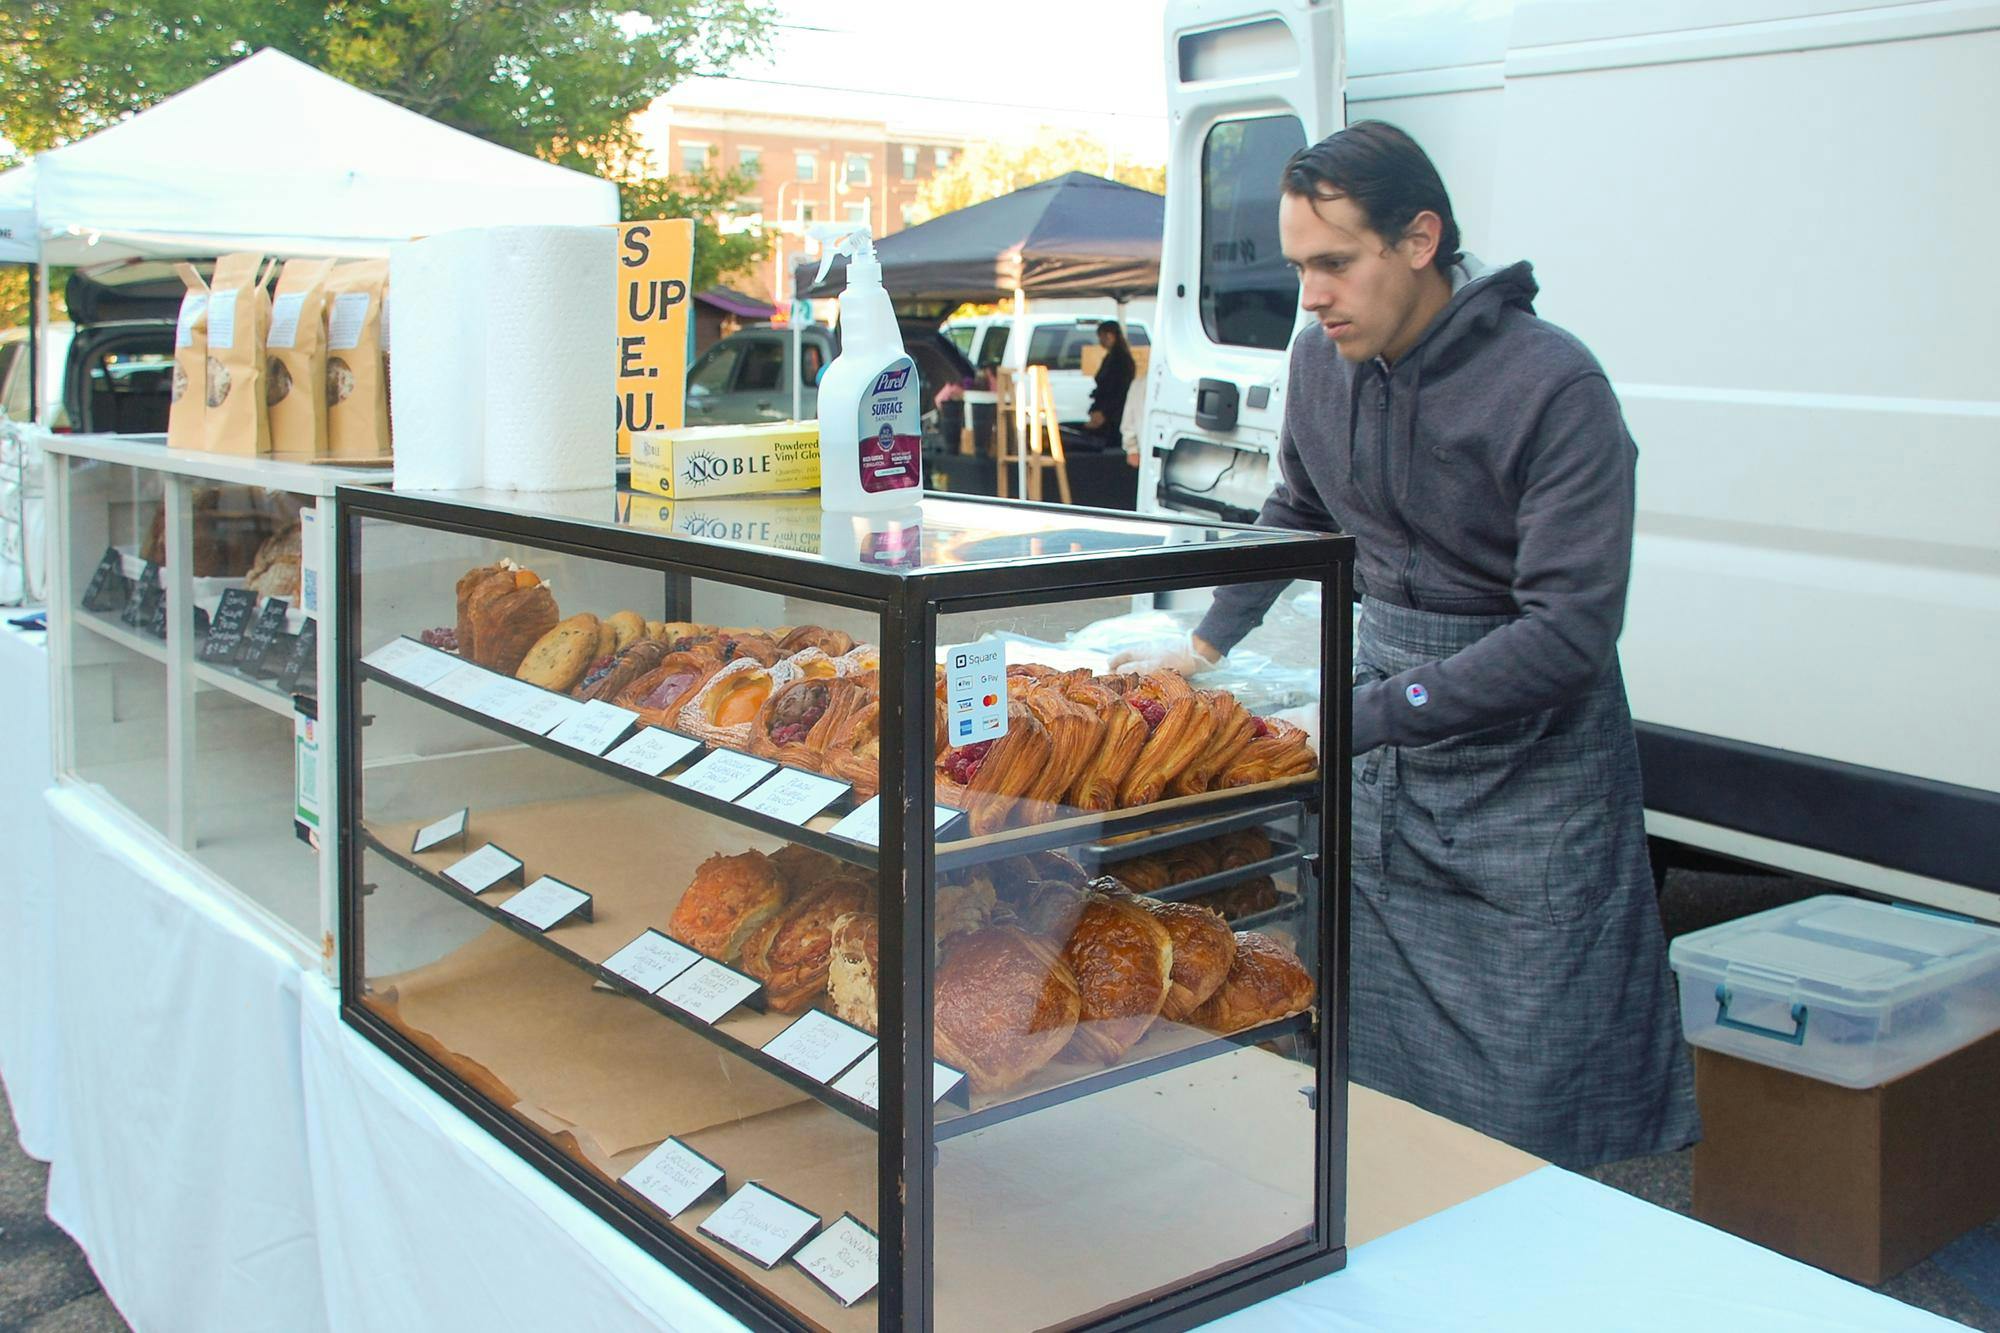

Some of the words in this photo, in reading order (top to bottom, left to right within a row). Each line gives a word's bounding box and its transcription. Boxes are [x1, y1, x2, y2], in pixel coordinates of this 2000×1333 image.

[617, 226, 651, 267] S
[629, 280, 686, 322] UP
[617, 336, 658, 377] E.
[877, 371, 908, 390] Purell
[871, 402, 903, 416] SURFACE
[774, 439, 819, 451] Powdered
[692, 454, 771, 478] NOBLE
[775, 451, 798, 463] Vinyl
[969, 652, 997, 664] Square
[730, 1201, 789, 1239] BROWNIES
